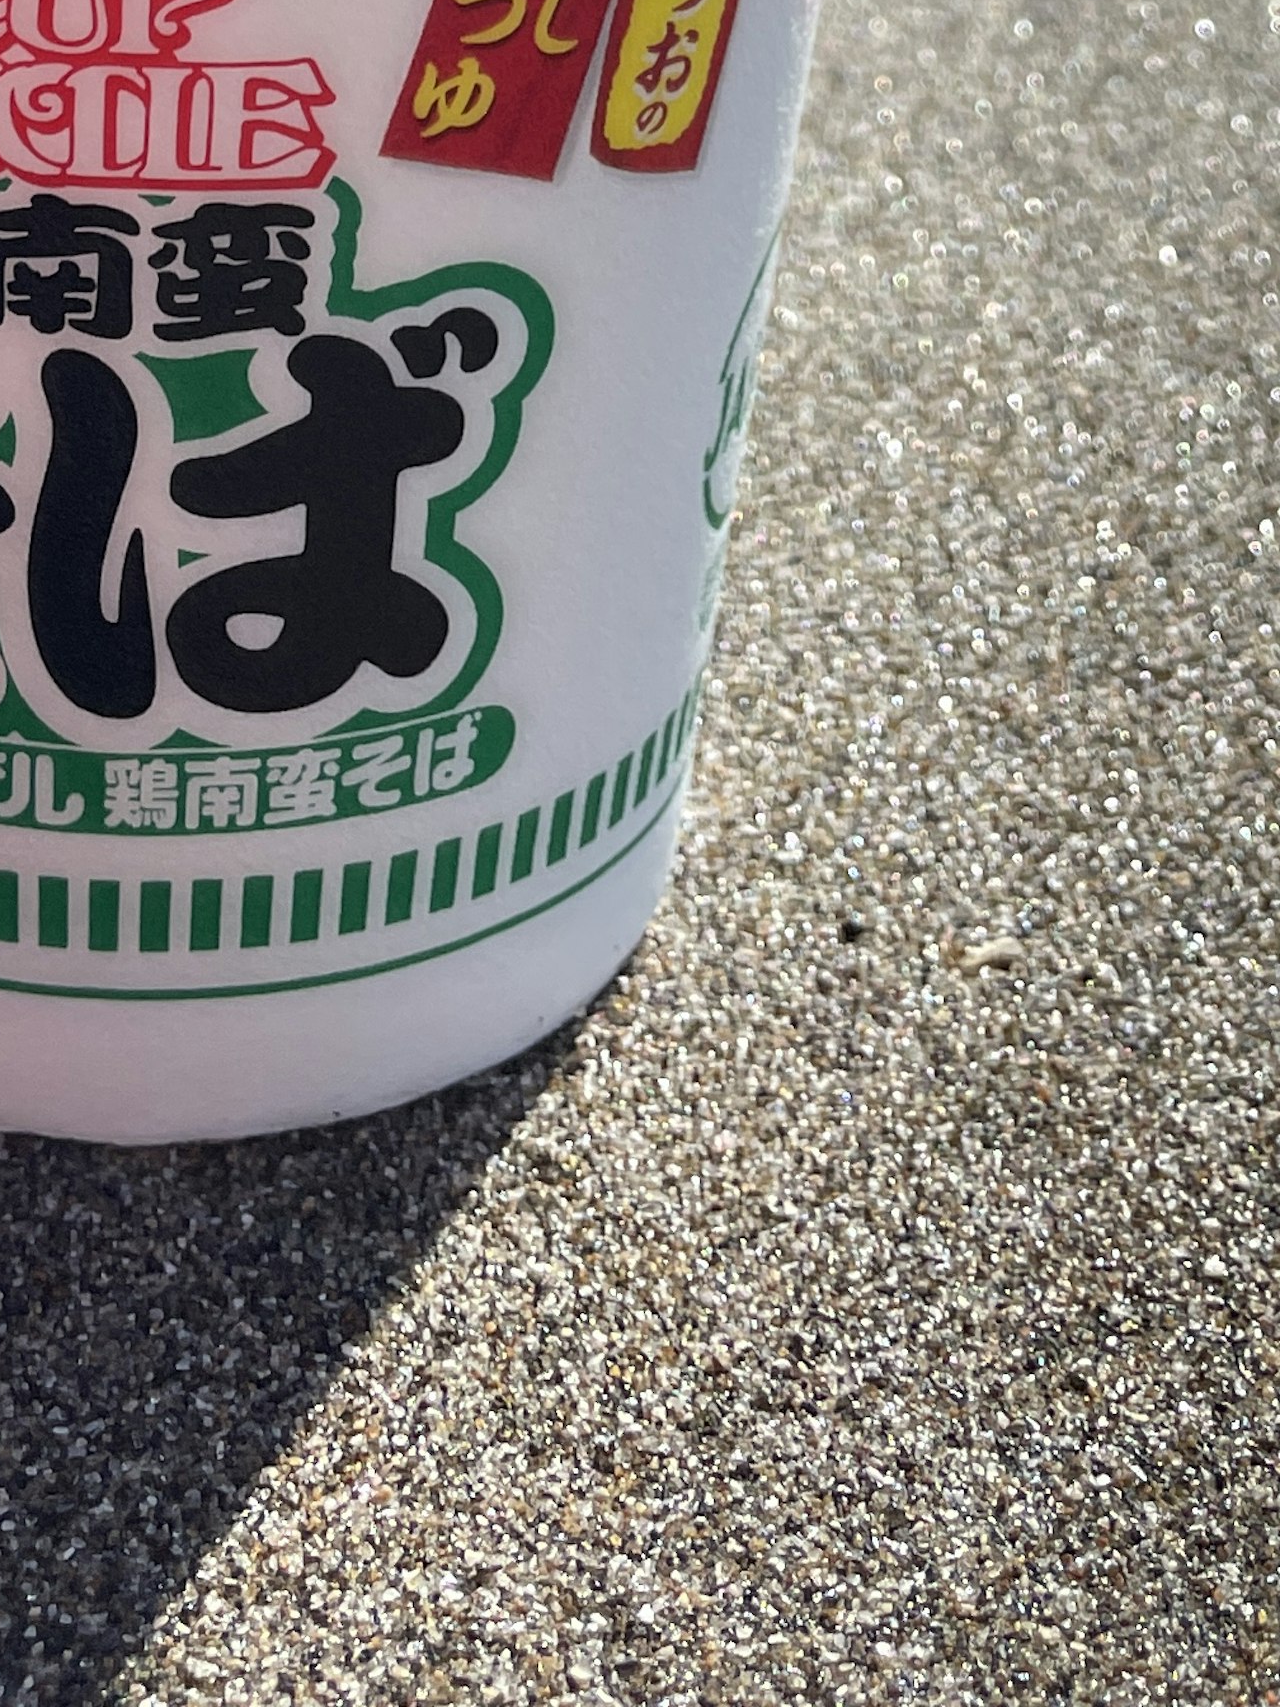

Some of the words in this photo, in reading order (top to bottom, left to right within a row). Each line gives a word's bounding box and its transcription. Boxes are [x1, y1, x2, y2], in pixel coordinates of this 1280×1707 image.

[103, 709, 483, 831] 鶏南蛮そば
